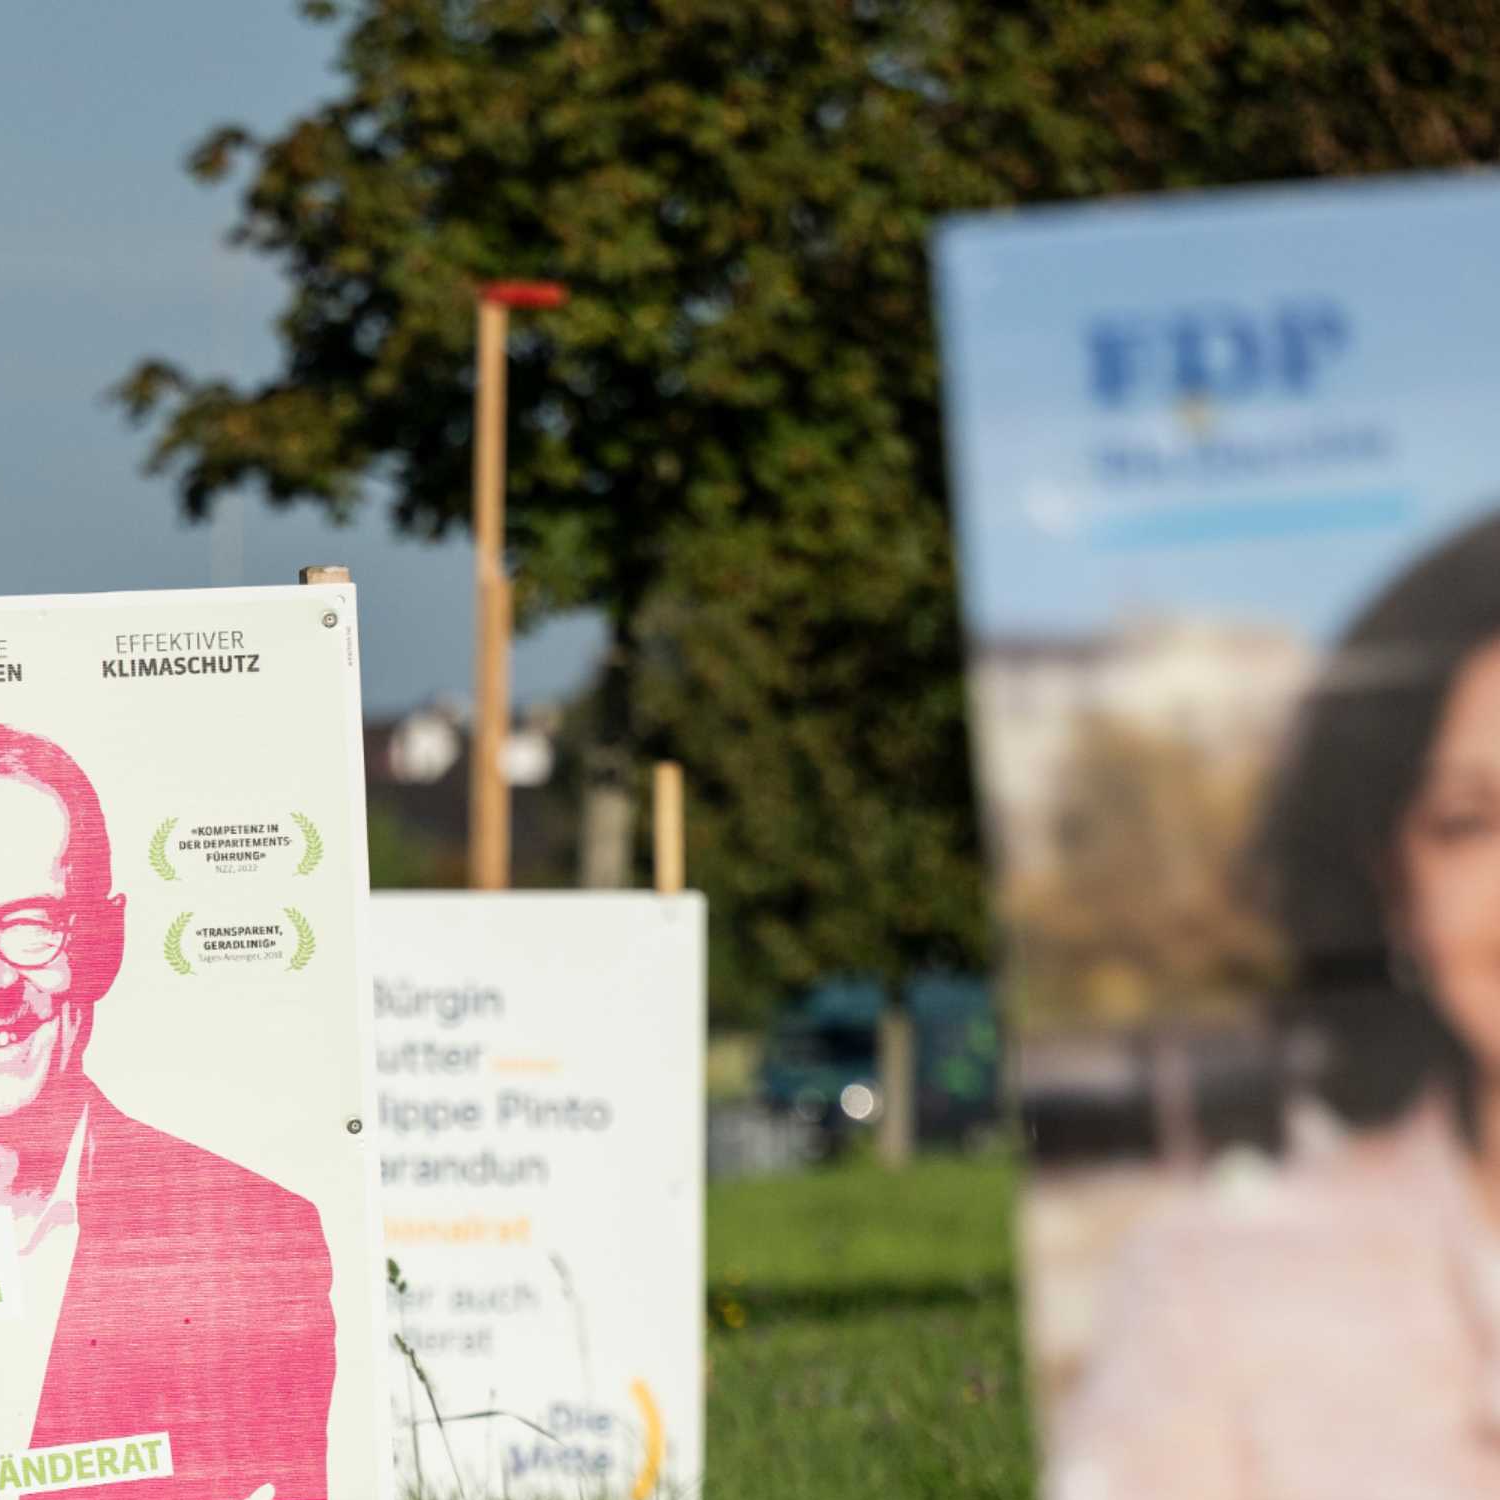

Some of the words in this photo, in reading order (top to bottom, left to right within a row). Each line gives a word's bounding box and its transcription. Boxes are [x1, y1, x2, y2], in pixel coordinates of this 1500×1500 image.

[115, 630, 244, 654] EFFEKTIVER
[102, 654, 260, 678] KLIMASCHUTZ
[191, 824, 265, 836] «KOMPETENZ
[267, 824, 279, 833] IN
[179, 840, 201, 850] DER
[203, 837, 292, 849] DEPARTEMENTS-
[206, 850, 266, 862] FÜHRUNG»
[196, 925, 283, 937] «TRANSPARENT,
[203, 938, 276, 951] GERADLINIG»
[497, 1089, 614, 1132] Pinto
